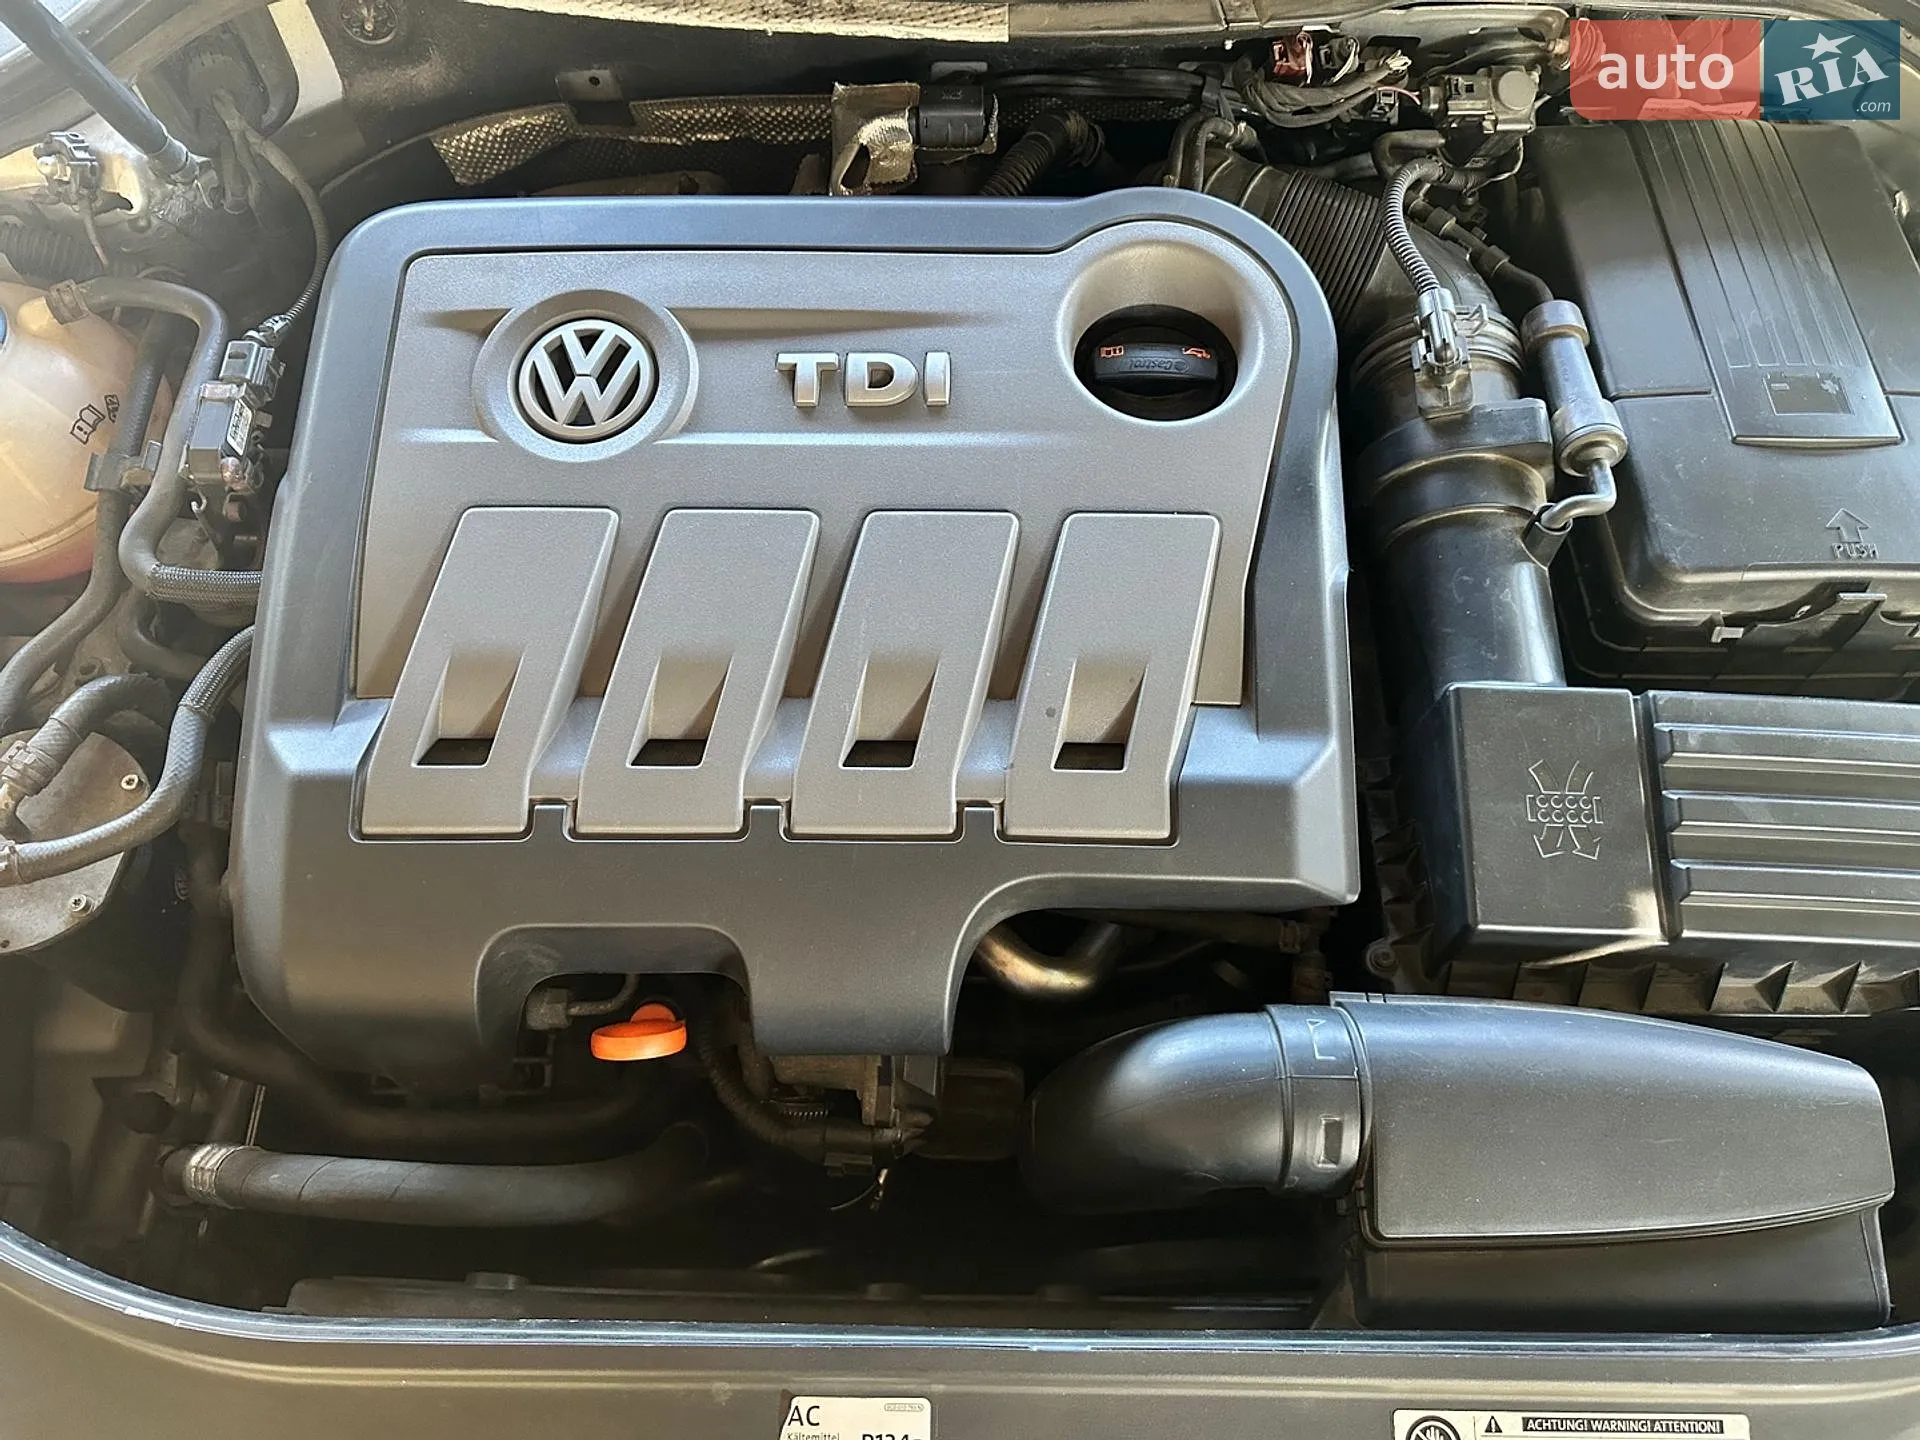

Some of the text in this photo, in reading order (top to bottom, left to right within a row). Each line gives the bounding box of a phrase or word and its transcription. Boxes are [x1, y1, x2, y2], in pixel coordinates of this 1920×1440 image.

[1129, 357, 1172, 371] Castrol
[775, 351, 951, 408] TDI
[1831, 543, 1879, 560] PUSH
[787, 1405, 820, 1427] AC
[1526, 1418, 1720, 1433] ACHTUNG! WARNING! ATTENTION!
